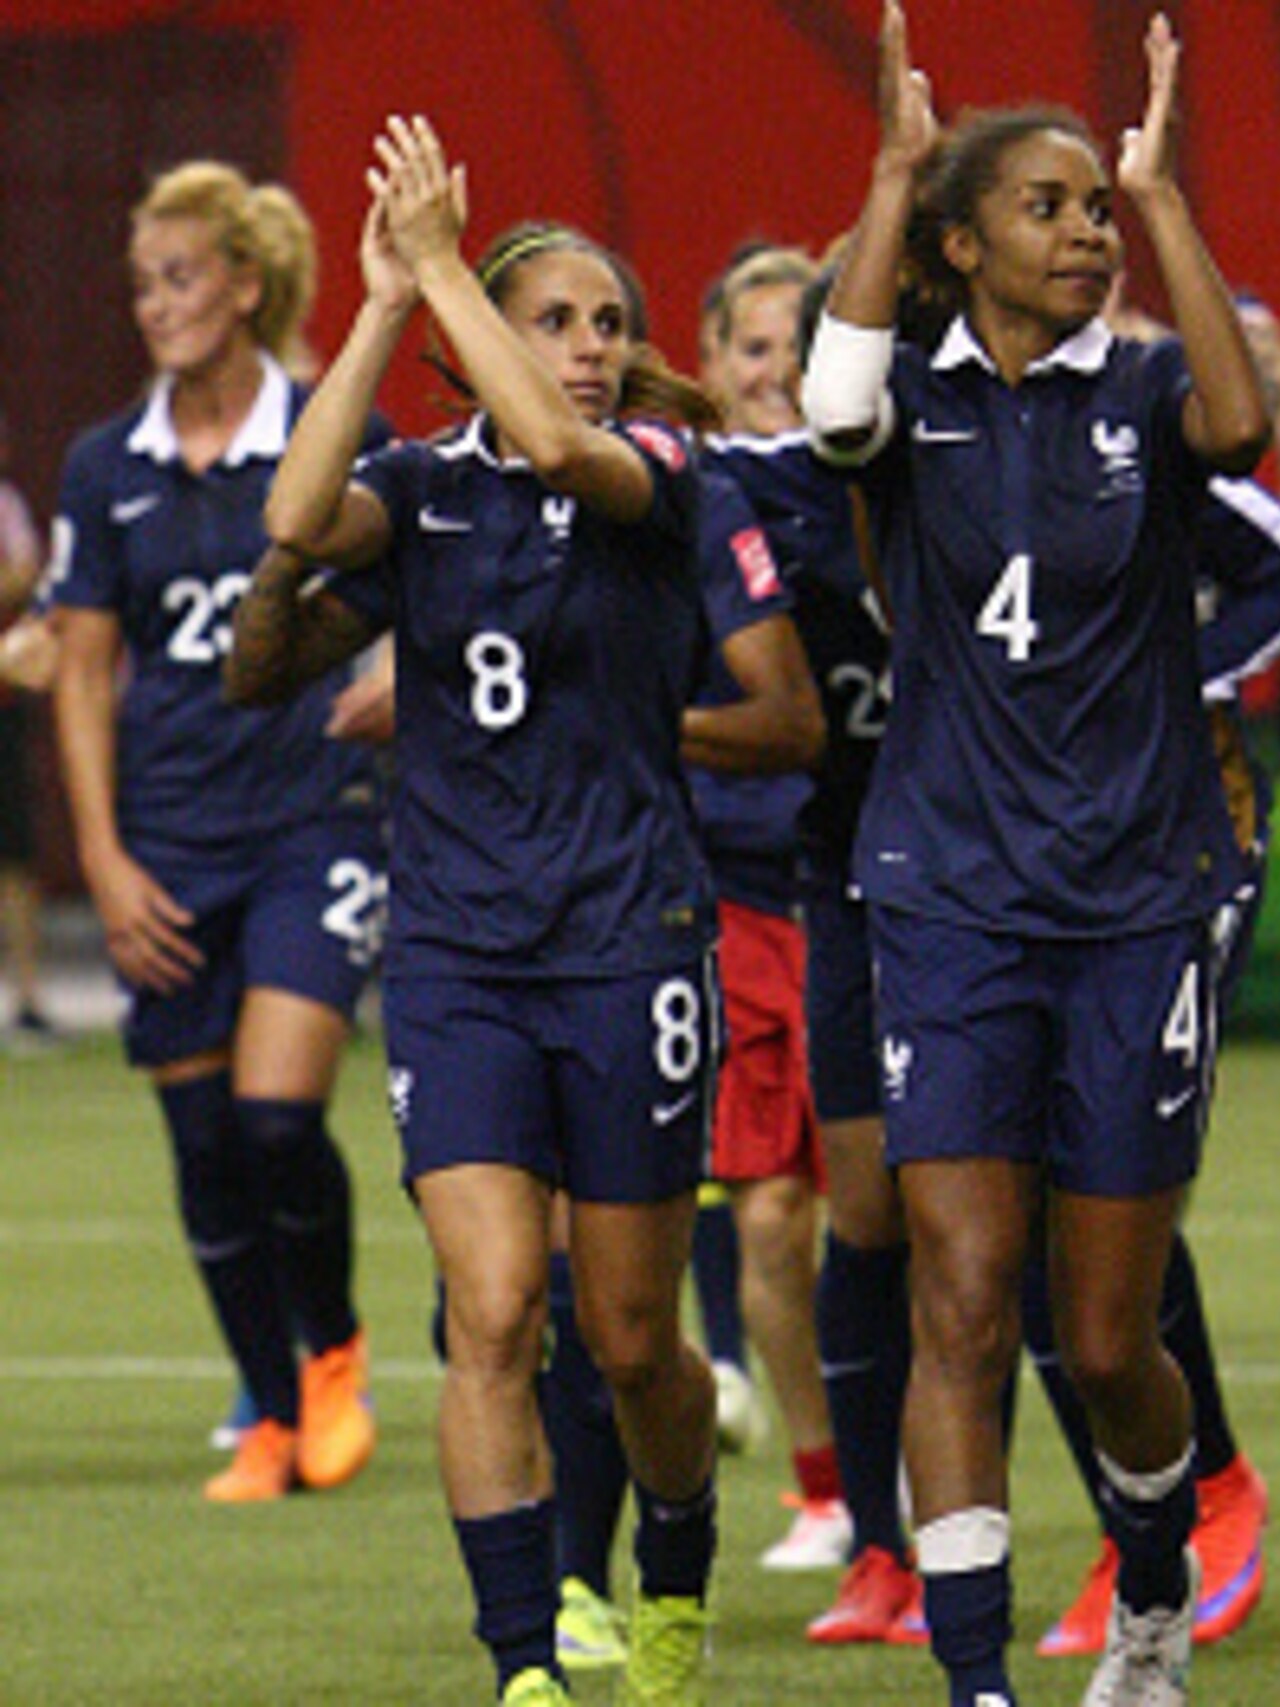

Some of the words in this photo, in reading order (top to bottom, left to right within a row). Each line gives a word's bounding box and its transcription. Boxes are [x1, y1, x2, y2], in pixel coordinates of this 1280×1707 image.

[976, 553, 1038, 662] 4
[465, 631, 527, 729] 8
[651, 978, 700, 1081] 8
[1162, 961, 1199, 1068] 4
